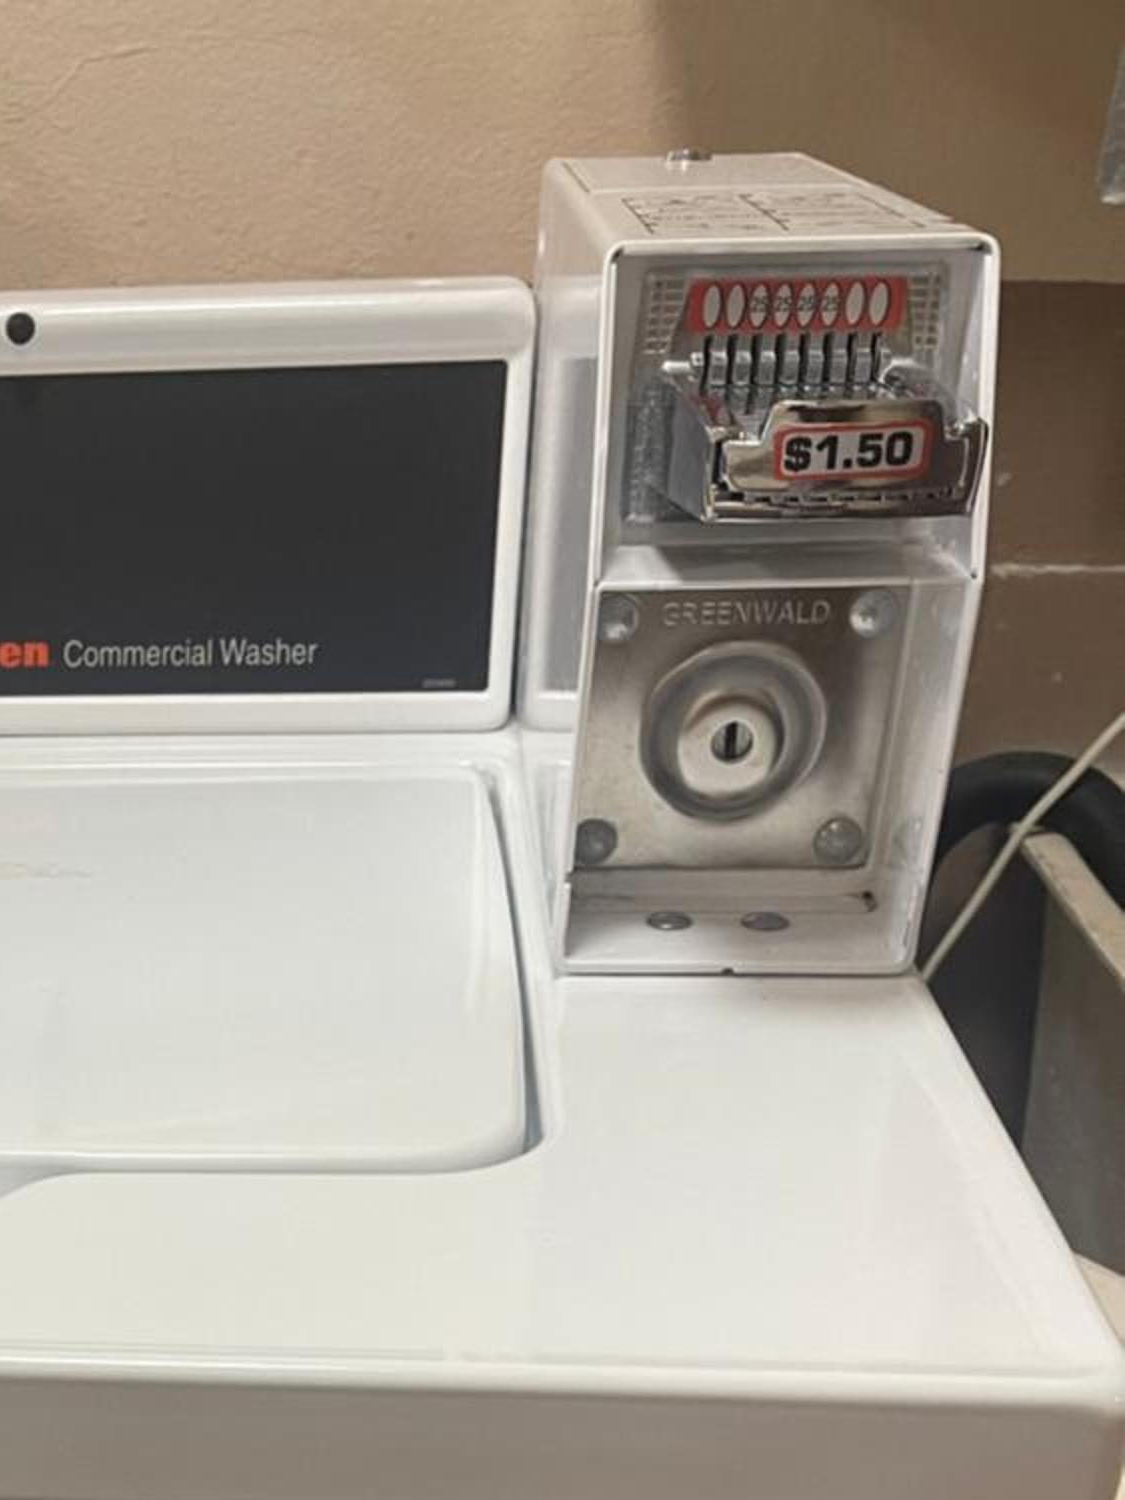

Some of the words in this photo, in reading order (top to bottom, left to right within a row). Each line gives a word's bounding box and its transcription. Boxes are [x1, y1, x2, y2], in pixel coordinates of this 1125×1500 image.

[784, 431, 914, 472] $1.50
[663, 599, 831, 626] GREENWALD
[62, 638, 213, 668] Commercial
[220, 638, 318, 667] Washer
